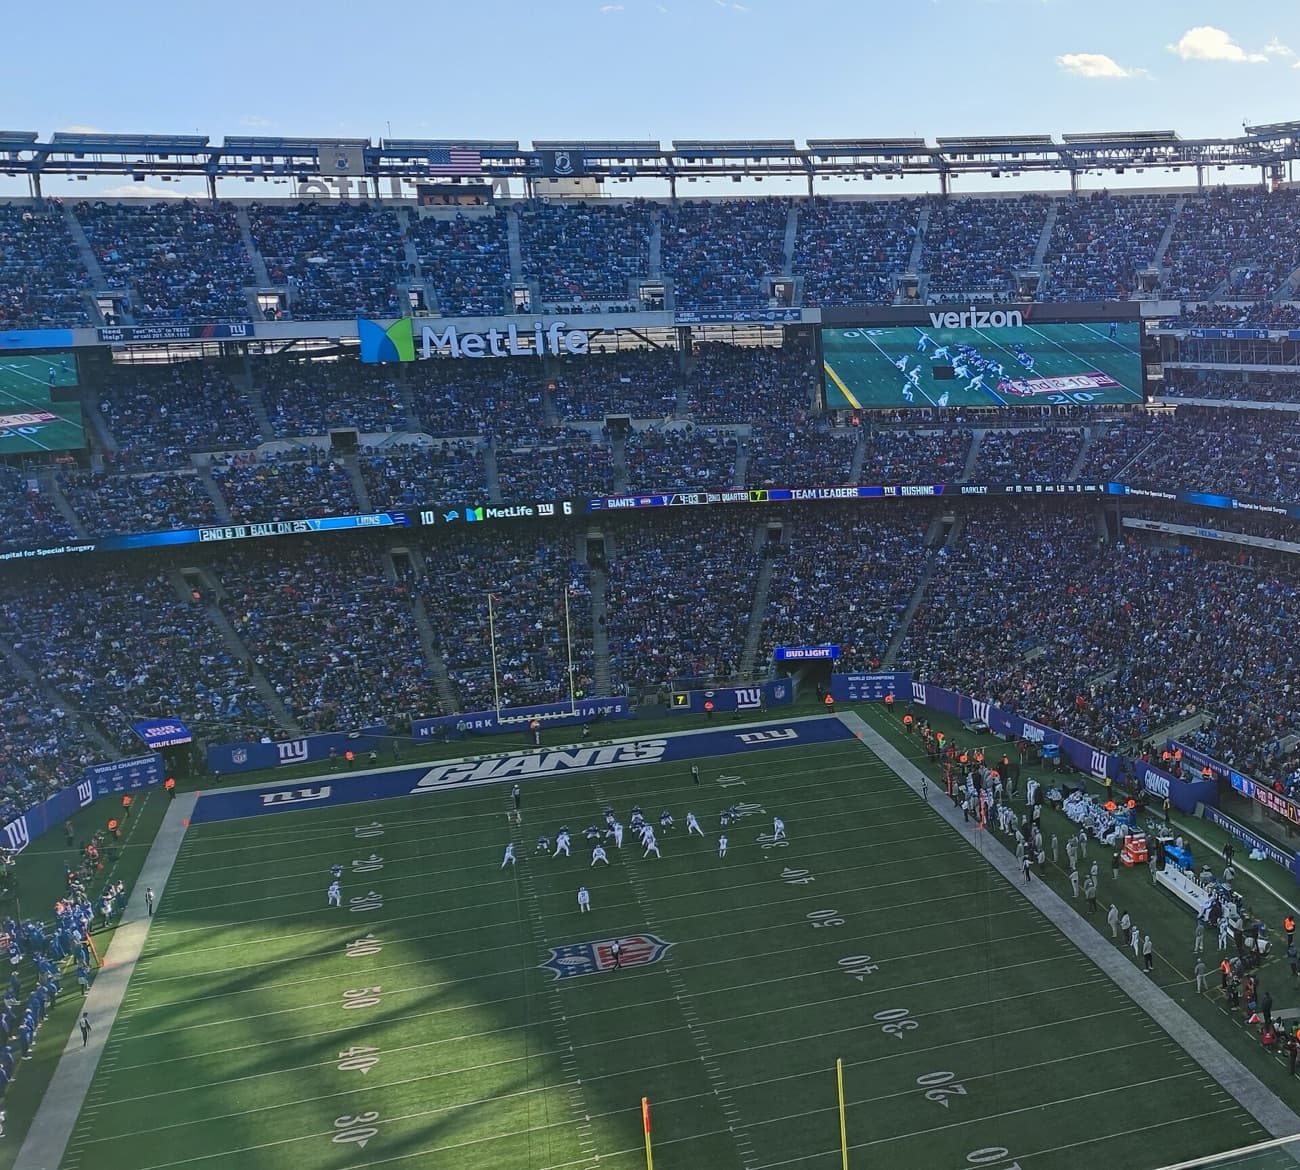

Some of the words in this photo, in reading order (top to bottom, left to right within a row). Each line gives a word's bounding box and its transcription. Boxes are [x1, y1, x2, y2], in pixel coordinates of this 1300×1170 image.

[929, 306, 1023, 329] verizon
[422, 321, 590, 358] MetLife
[608, 498, 635, 507] GIANTS
[722, 492, 749, 502] QUARTER
[790, 489, 816, 499] TEAM
[819, 488, 858, 498] LEADERS
[901, 486, 934, 495] RUSHING
[356, 515, 381, 526] LIONS
[421, 511, 434, 525] 10
[486, 505, 533, 519] MetLife
[537, 503, 554, 515] ny
[563, 502, 573, 515] 6
[203, 528, 224, 541] 2ND
[225, 527, 233, 539] &
[235, 527, 245, 538] 10
[251, 524, 276, 536] BALL
[278, 523, 291, 533] ON
[24, 549, 35, 557] for
[37, 546, 64, 556] Special
[66, 544, 96, 553] Surgery
[786, 650, 804, 658] BUD
[805, 649, 830, 657] LIGHT
[676, 695, 684, 704] 7
[735, 688, 761, 709] ny
[912, 682, 926, 704] ny
[149, 740, 170, 749] METLIFE
[735, 728, 799, 744] ny
[277, 740, 308, 764] ny
[94, 764, 117, 774] WORLD
[118, 757, 156, 769] CHAMPIONS
[412, 740, 668, 790] GIANTS
[1091, 751, 1107, 779] ny
[77, 779, 93, 807] ny
[1144, 770, 1170, 799] GIANTS
[259, 786, 331, 806] ny
[3, 816, 29, 855] ny
[349, 894, 384, 913] 30
[806, 909, 846, 928] 50
[345, 938, 383, 958] 40
[838, 955, 881, 976] 40
[342, 986, 382, 1010] 50
[872, 1008, 920, 1034] 30
[338, 1046, 382, 1071] 40
[916, 1071, 969, 1103] 20
[332, 1112, 379, 1143] 30
